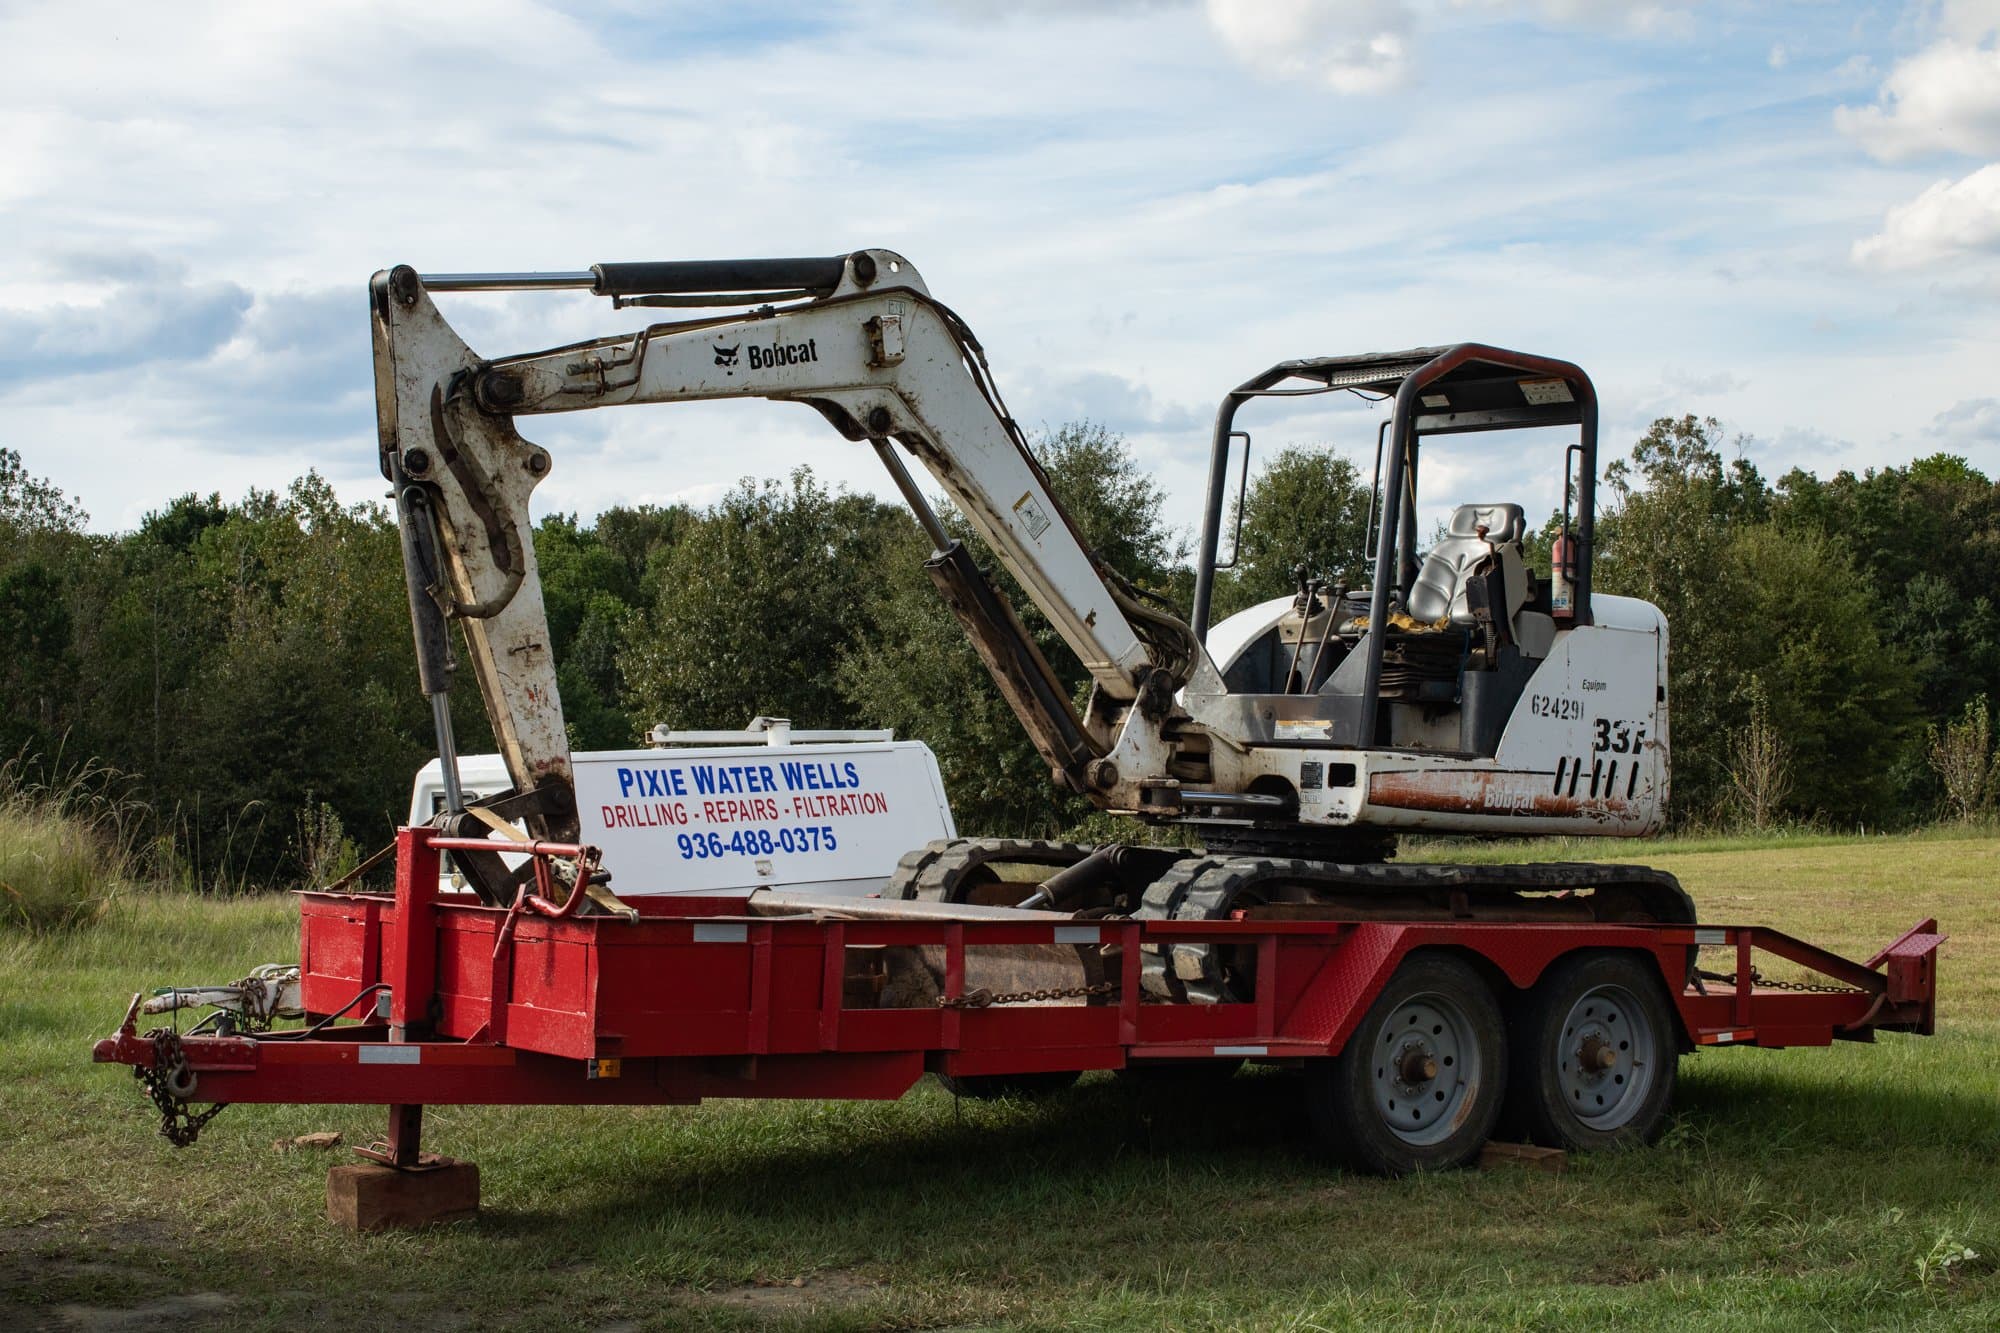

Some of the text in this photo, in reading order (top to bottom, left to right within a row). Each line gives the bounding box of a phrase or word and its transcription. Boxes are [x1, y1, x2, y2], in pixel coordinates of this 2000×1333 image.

[747, 339, 818, 370] Bobcat
[617, 761, 861, 799] PIXIE WATER WELLS
[601, 801, 689, 829] DRILLING
[703, 797, 779, 824] REPAIRS
[792, 792, 888, 819] FILTRATION
[676, 825, 839, 861] 936-488-0375
